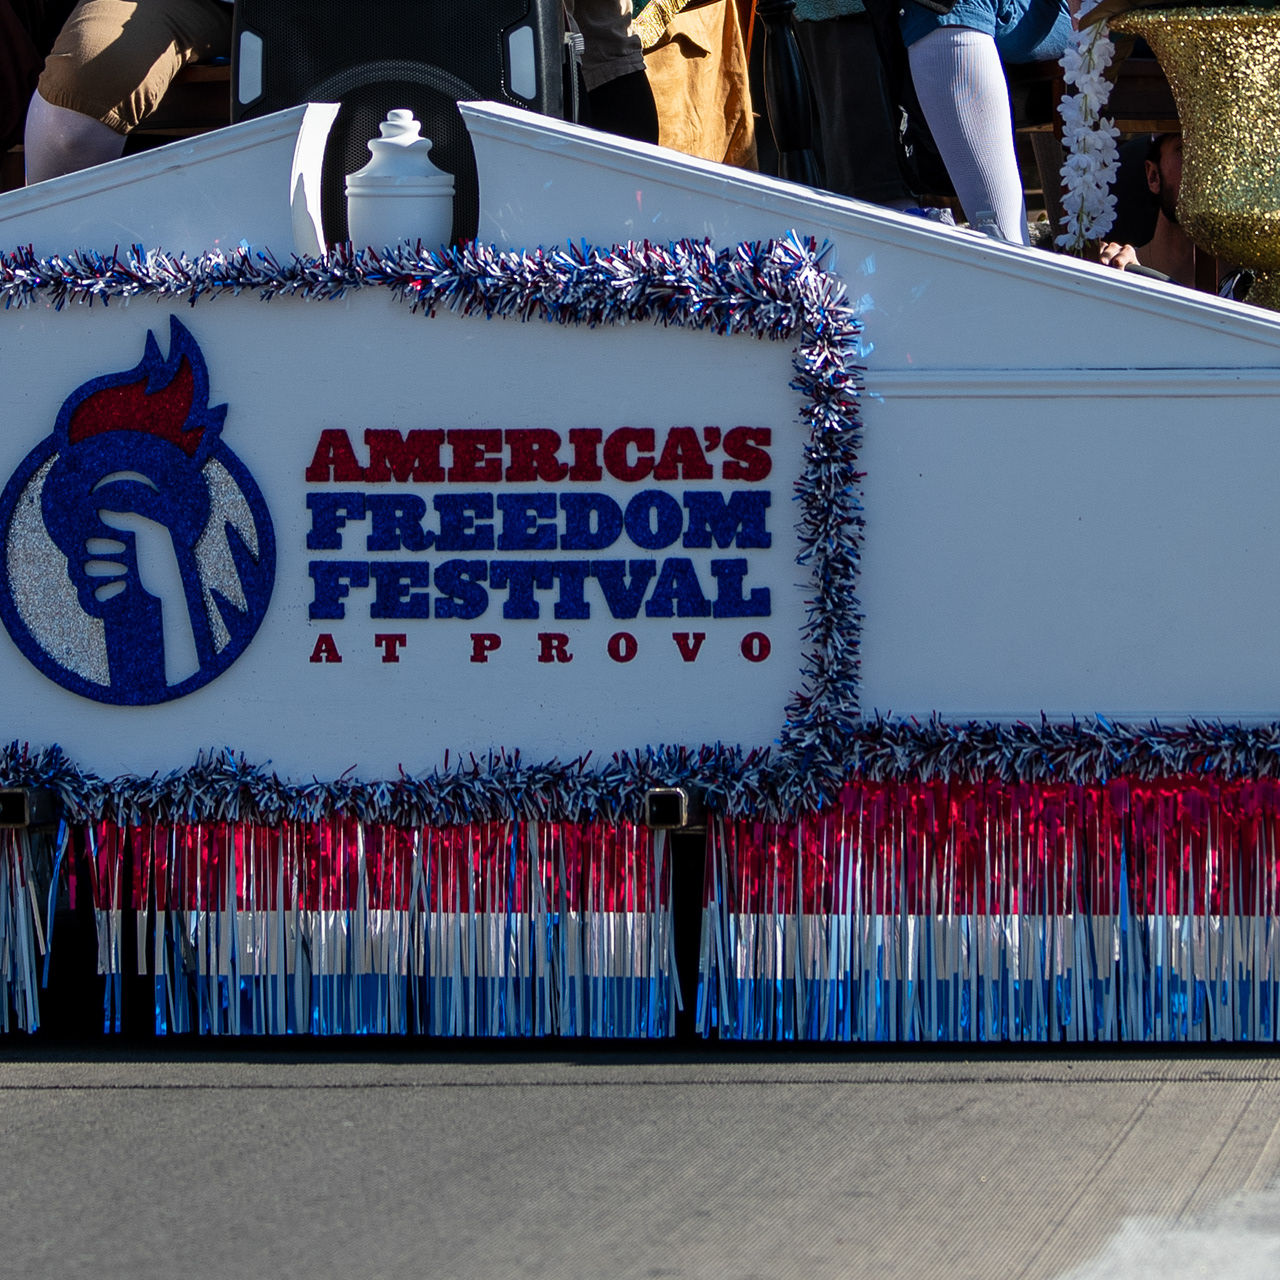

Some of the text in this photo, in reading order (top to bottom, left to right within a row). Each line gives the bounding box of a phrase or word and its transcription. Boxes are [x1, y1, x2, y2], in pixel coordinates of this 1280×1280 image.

[305, 426, 773, 483] AMERICA'S
[305, 489, 773, 552] FREEDOM
[308, 557, 772, 621] FESTIVAL
[309, 631, 772, 664] AT PROVO
